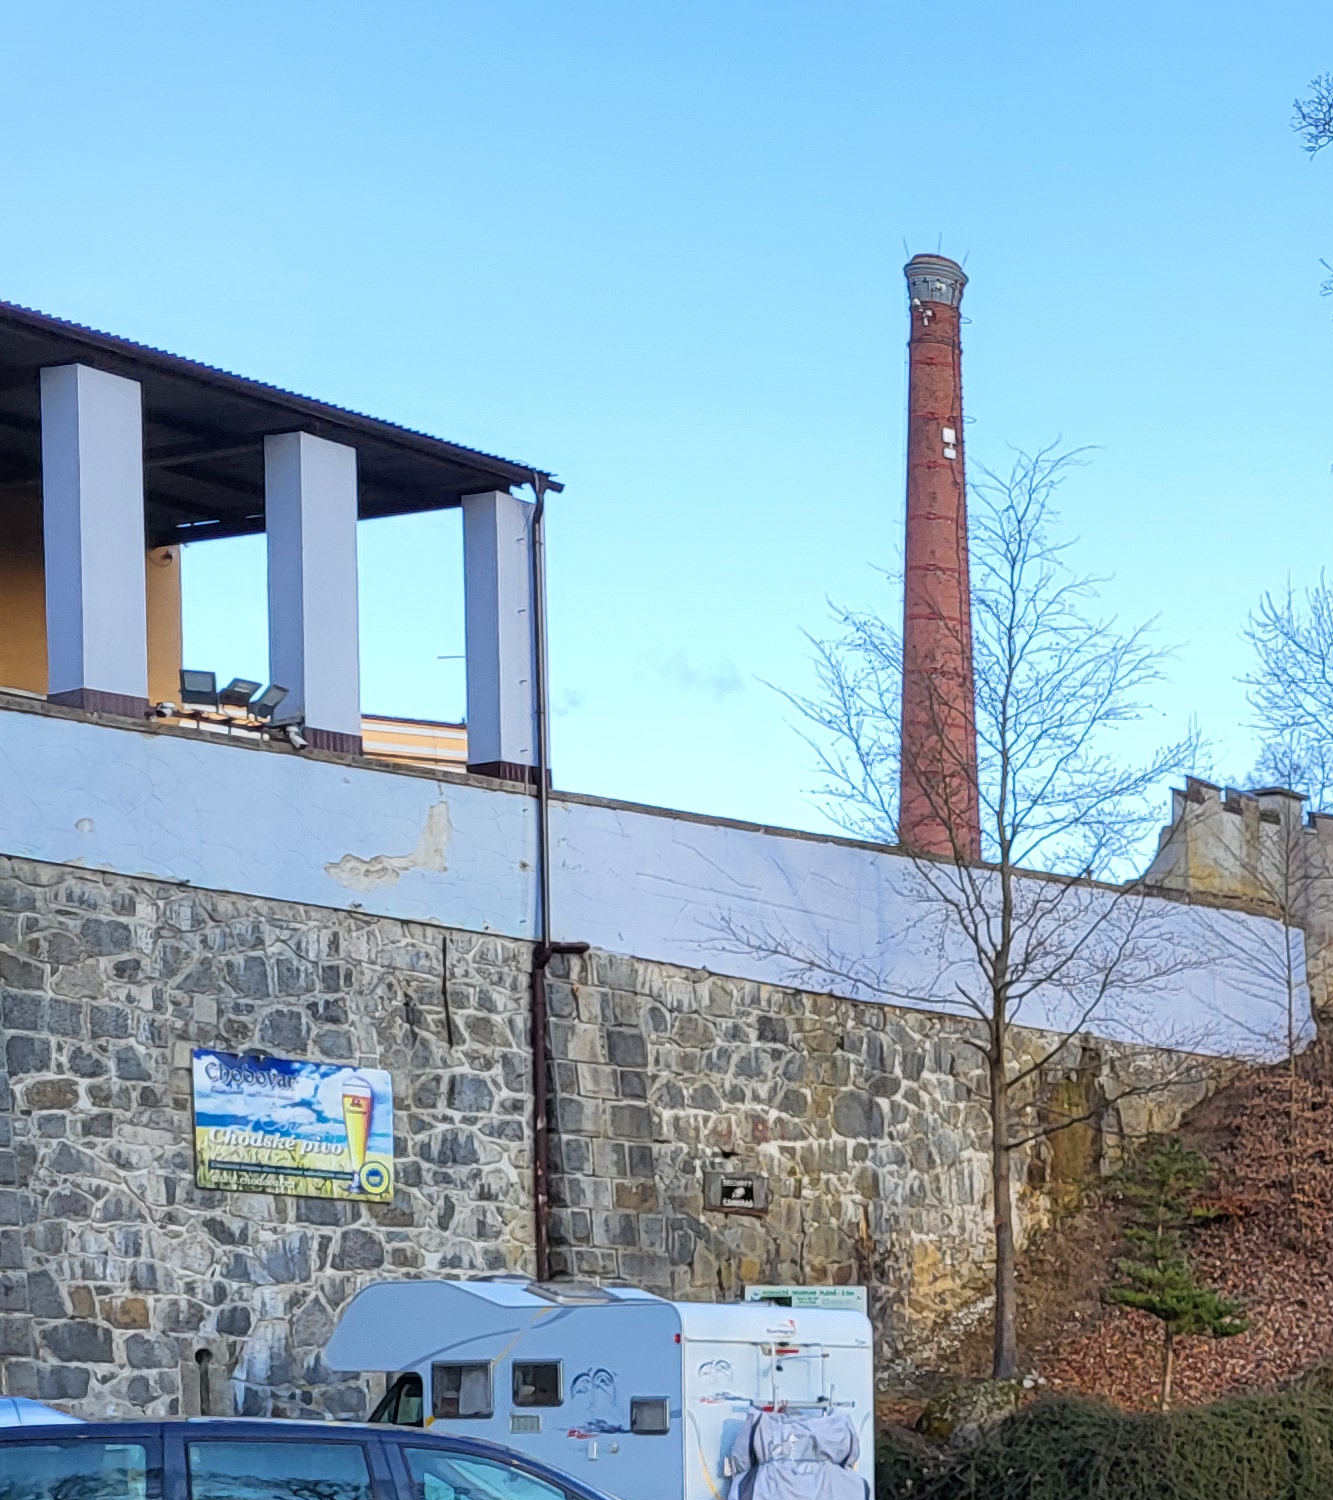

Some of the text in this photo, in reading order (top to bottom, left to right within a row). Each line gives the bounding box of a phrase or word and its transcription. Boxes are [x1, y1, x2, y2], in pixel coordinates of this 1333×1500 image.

[204, 1061, 299, 1089] Chodovar
[209, 1128, 343, 1156] Chodské pivo
